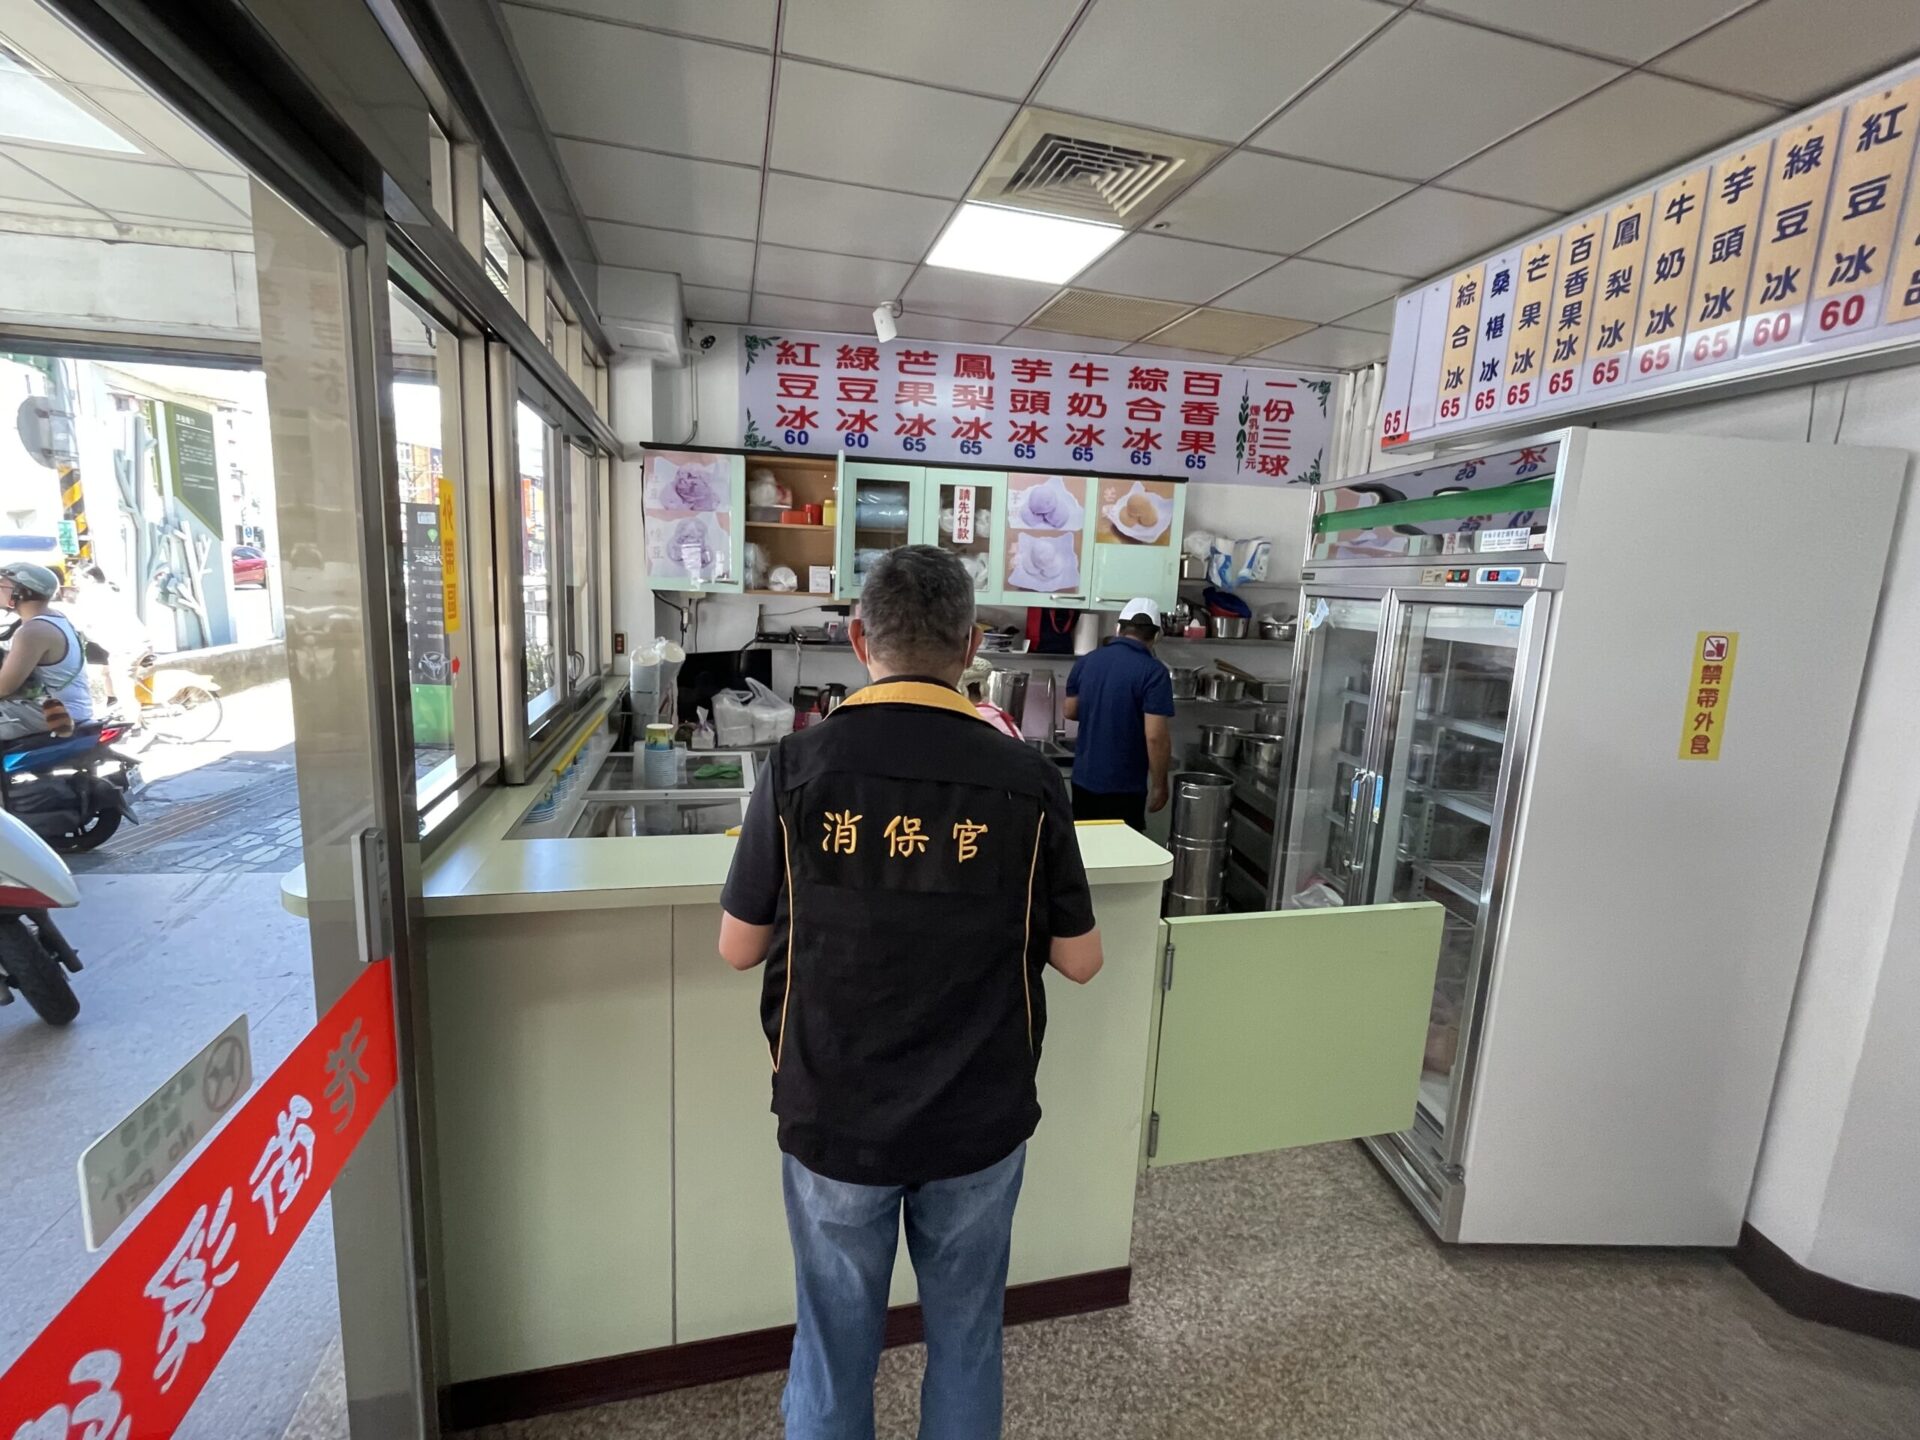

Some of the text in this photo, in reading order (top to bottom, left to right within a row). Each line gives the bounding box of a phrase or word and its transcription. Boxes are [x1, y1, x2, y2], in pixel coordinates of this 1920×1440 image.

[1760, 135, 1824, 304] 綠豆冰
[1828, 103, 1908, 287] 紅豆冰
[1645, 193, 1695, 337] 牛奶冰
[1699, 165, 1756, 322] 芋頭冰
[1553, 233, 1595, 363] 百香果冰
[1597, 213, 1641, 351] 鳳梨冰
[1444, 281, 1477, 390] 綜合冰
[1511, 253, 1550, 375] 芒果冰
[1753, 312, 1791, 346] 60
[1820, 295, 1865, 331] 60
[1593, 358, 1619, 385] 65
[1640, 345, 1670, 373] 65
[1694, 329, 1729, 361] 65
[776, 340, 820, 430] 紅豆冰
[836, 345, 880, 433] 綠豆冰
[894, 349, 938, 437] 芒果冰
[951, 353, 995, 440] 鳳梨冰
[1008, 358, 1052, 444] 芋頭冰
[1065, 362, 1109, 447] 牛奶冰
[1441, 397, 1460, 418] 65
[1475, 389, 1495, 411] 65
[1507, 383, 1530, 405] 65
[1549, 369, 1573, 394] 65
[1122, 366, 1169, 451] 綜合冰
[1177, 370, 1223, 455] 百香果
[1257, 381, 1298, 477] 一份三球
[1384, 410, 1401, 434] 65
[784, 430, 809, 445] 60
[845, 432, 869, 448] 60
[903, 436, 926, 452] 65
[960, 440, 982, 455] 65
[1014, 444, 1036, 459] 65
[1072, 447, 1094, 462] 65
[1130, 451, 1152, 466] 65
[1185, 455, 1206, 469] 65
[957, 488, 970, 540] 請先付款
[1690, 664, 1723, 755] 禁帶外食
[822, 809, 988, 864] 消保官
